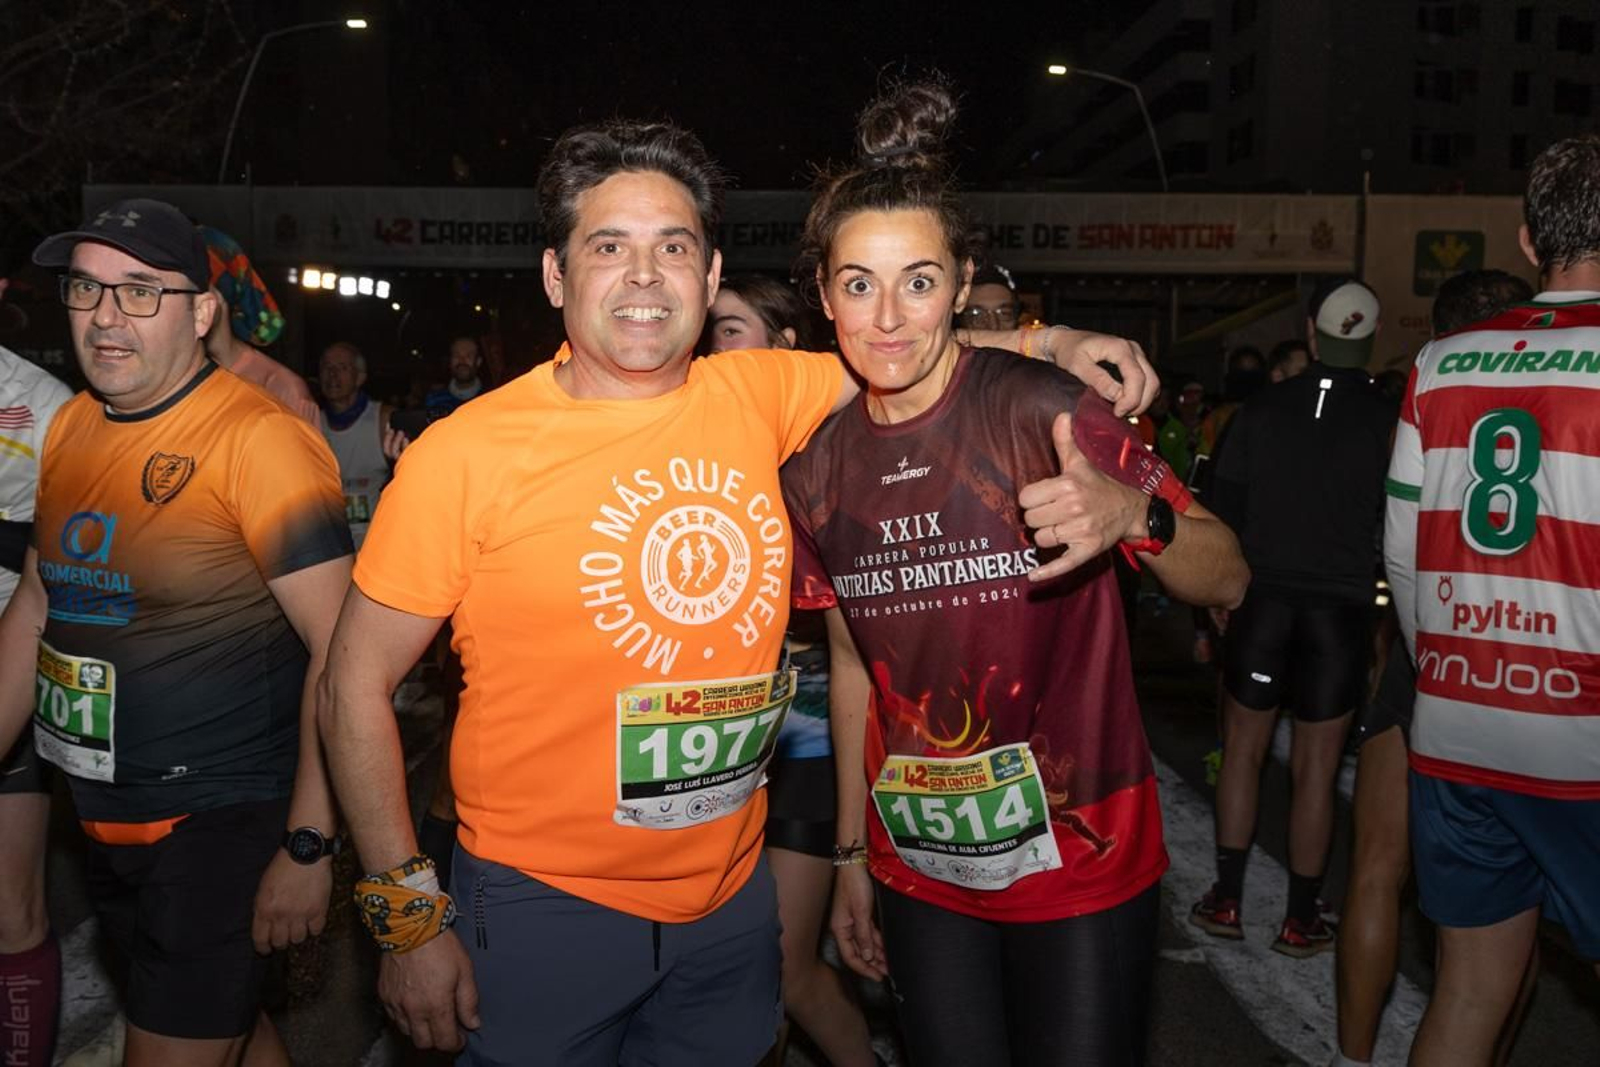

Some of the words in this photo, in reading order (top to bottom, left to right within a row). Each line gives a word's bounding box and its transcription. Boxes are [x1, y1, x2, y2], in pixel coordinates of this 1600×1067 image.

[374, 218, 413, 245] 42
[1032, 223, 1071, 249] DE
[1077, 223, 1135, 250] SAN
[668, 457, 745, 504] QUE
[1461, 407, 1541, 556] 8
[590, 468, 665, 542] MÁS
[655, 510, 717, 541] BEER
[879, 511, 943, 545] XXIX
[854, 549, 909, 568] CARRERA
[920, 537, 990, 559] POPULAR
[732, 492, 786, 648] CORRER
[832, 570, 895, 599] NUTRIAS
[899, 547, 1040, 592] PANTANERAS
[651, 562, 747, 620] RUNNERS
[865, 605, 878, 618] de
[885, 599, 943, 616] octubre
[952, 595, 969, 607] de
[979, 587, 1019, 604] 2024
[579, 552, 682, 675] MUCHO
[1452, 600, 1557, 635] pyltin
[666, 690, 701, 716] 42
[703, 700, 727, 713] SAN
[639, 706, 783, 780] 1977
[702, 770, 735, 785] LLAVERO
[904, 764, 928, 789] 42
[929, 777, 947, 789] SAN
[891, 783, 1034, 841] 1514
[959, 845, 978, 854] ALBA
